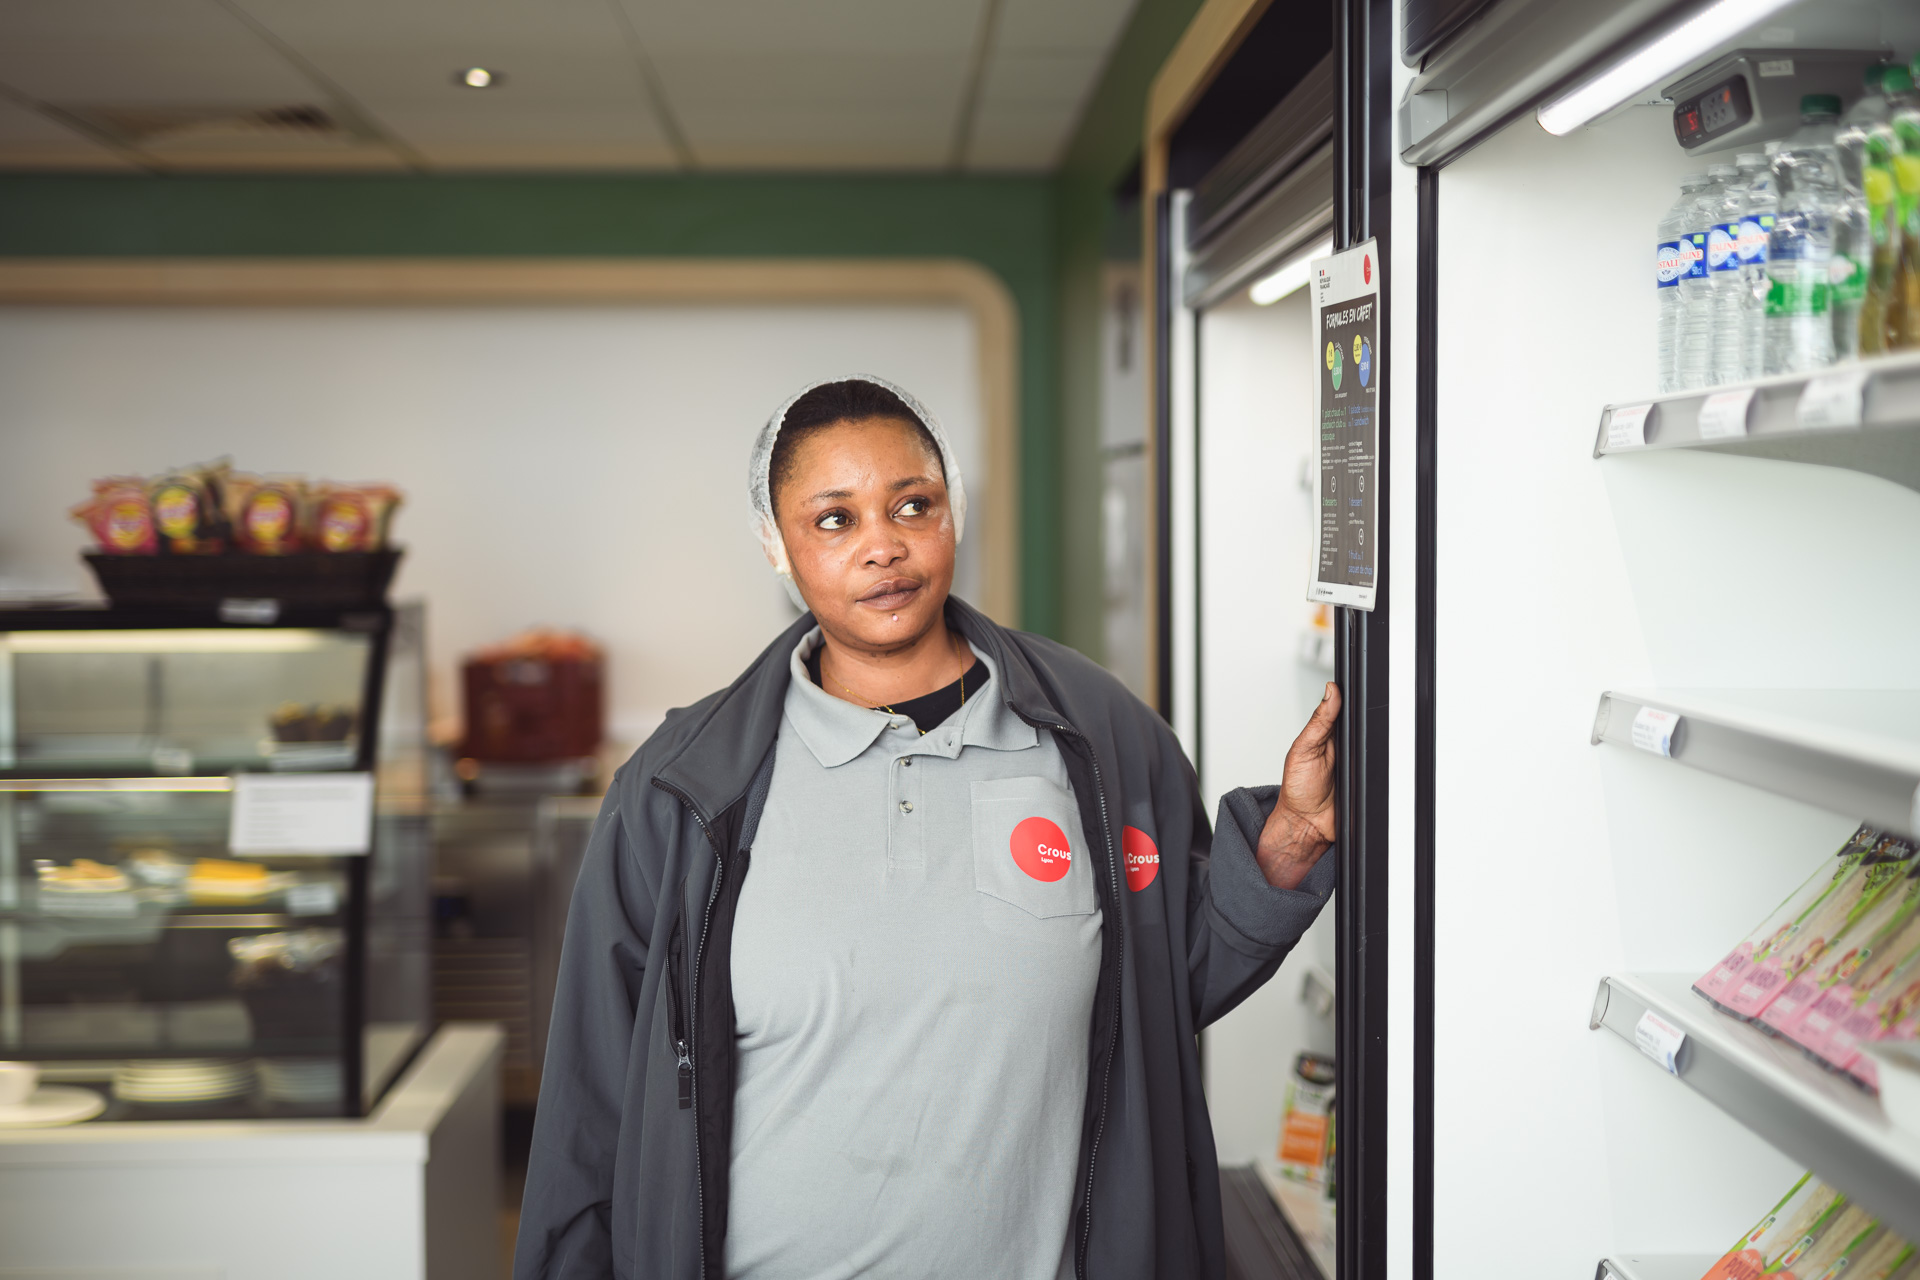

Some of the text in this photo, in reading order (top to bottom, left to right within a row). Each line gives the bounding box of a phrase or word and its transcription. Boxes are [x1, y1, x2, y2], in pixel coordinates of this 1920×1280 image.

[1326, 311, 1348, 330] FORMULES
[1349, 308, 1356, 323] EN
[1038, 844, 1072, 861] Crous
[1128, 853, 1160, 865] Crous
